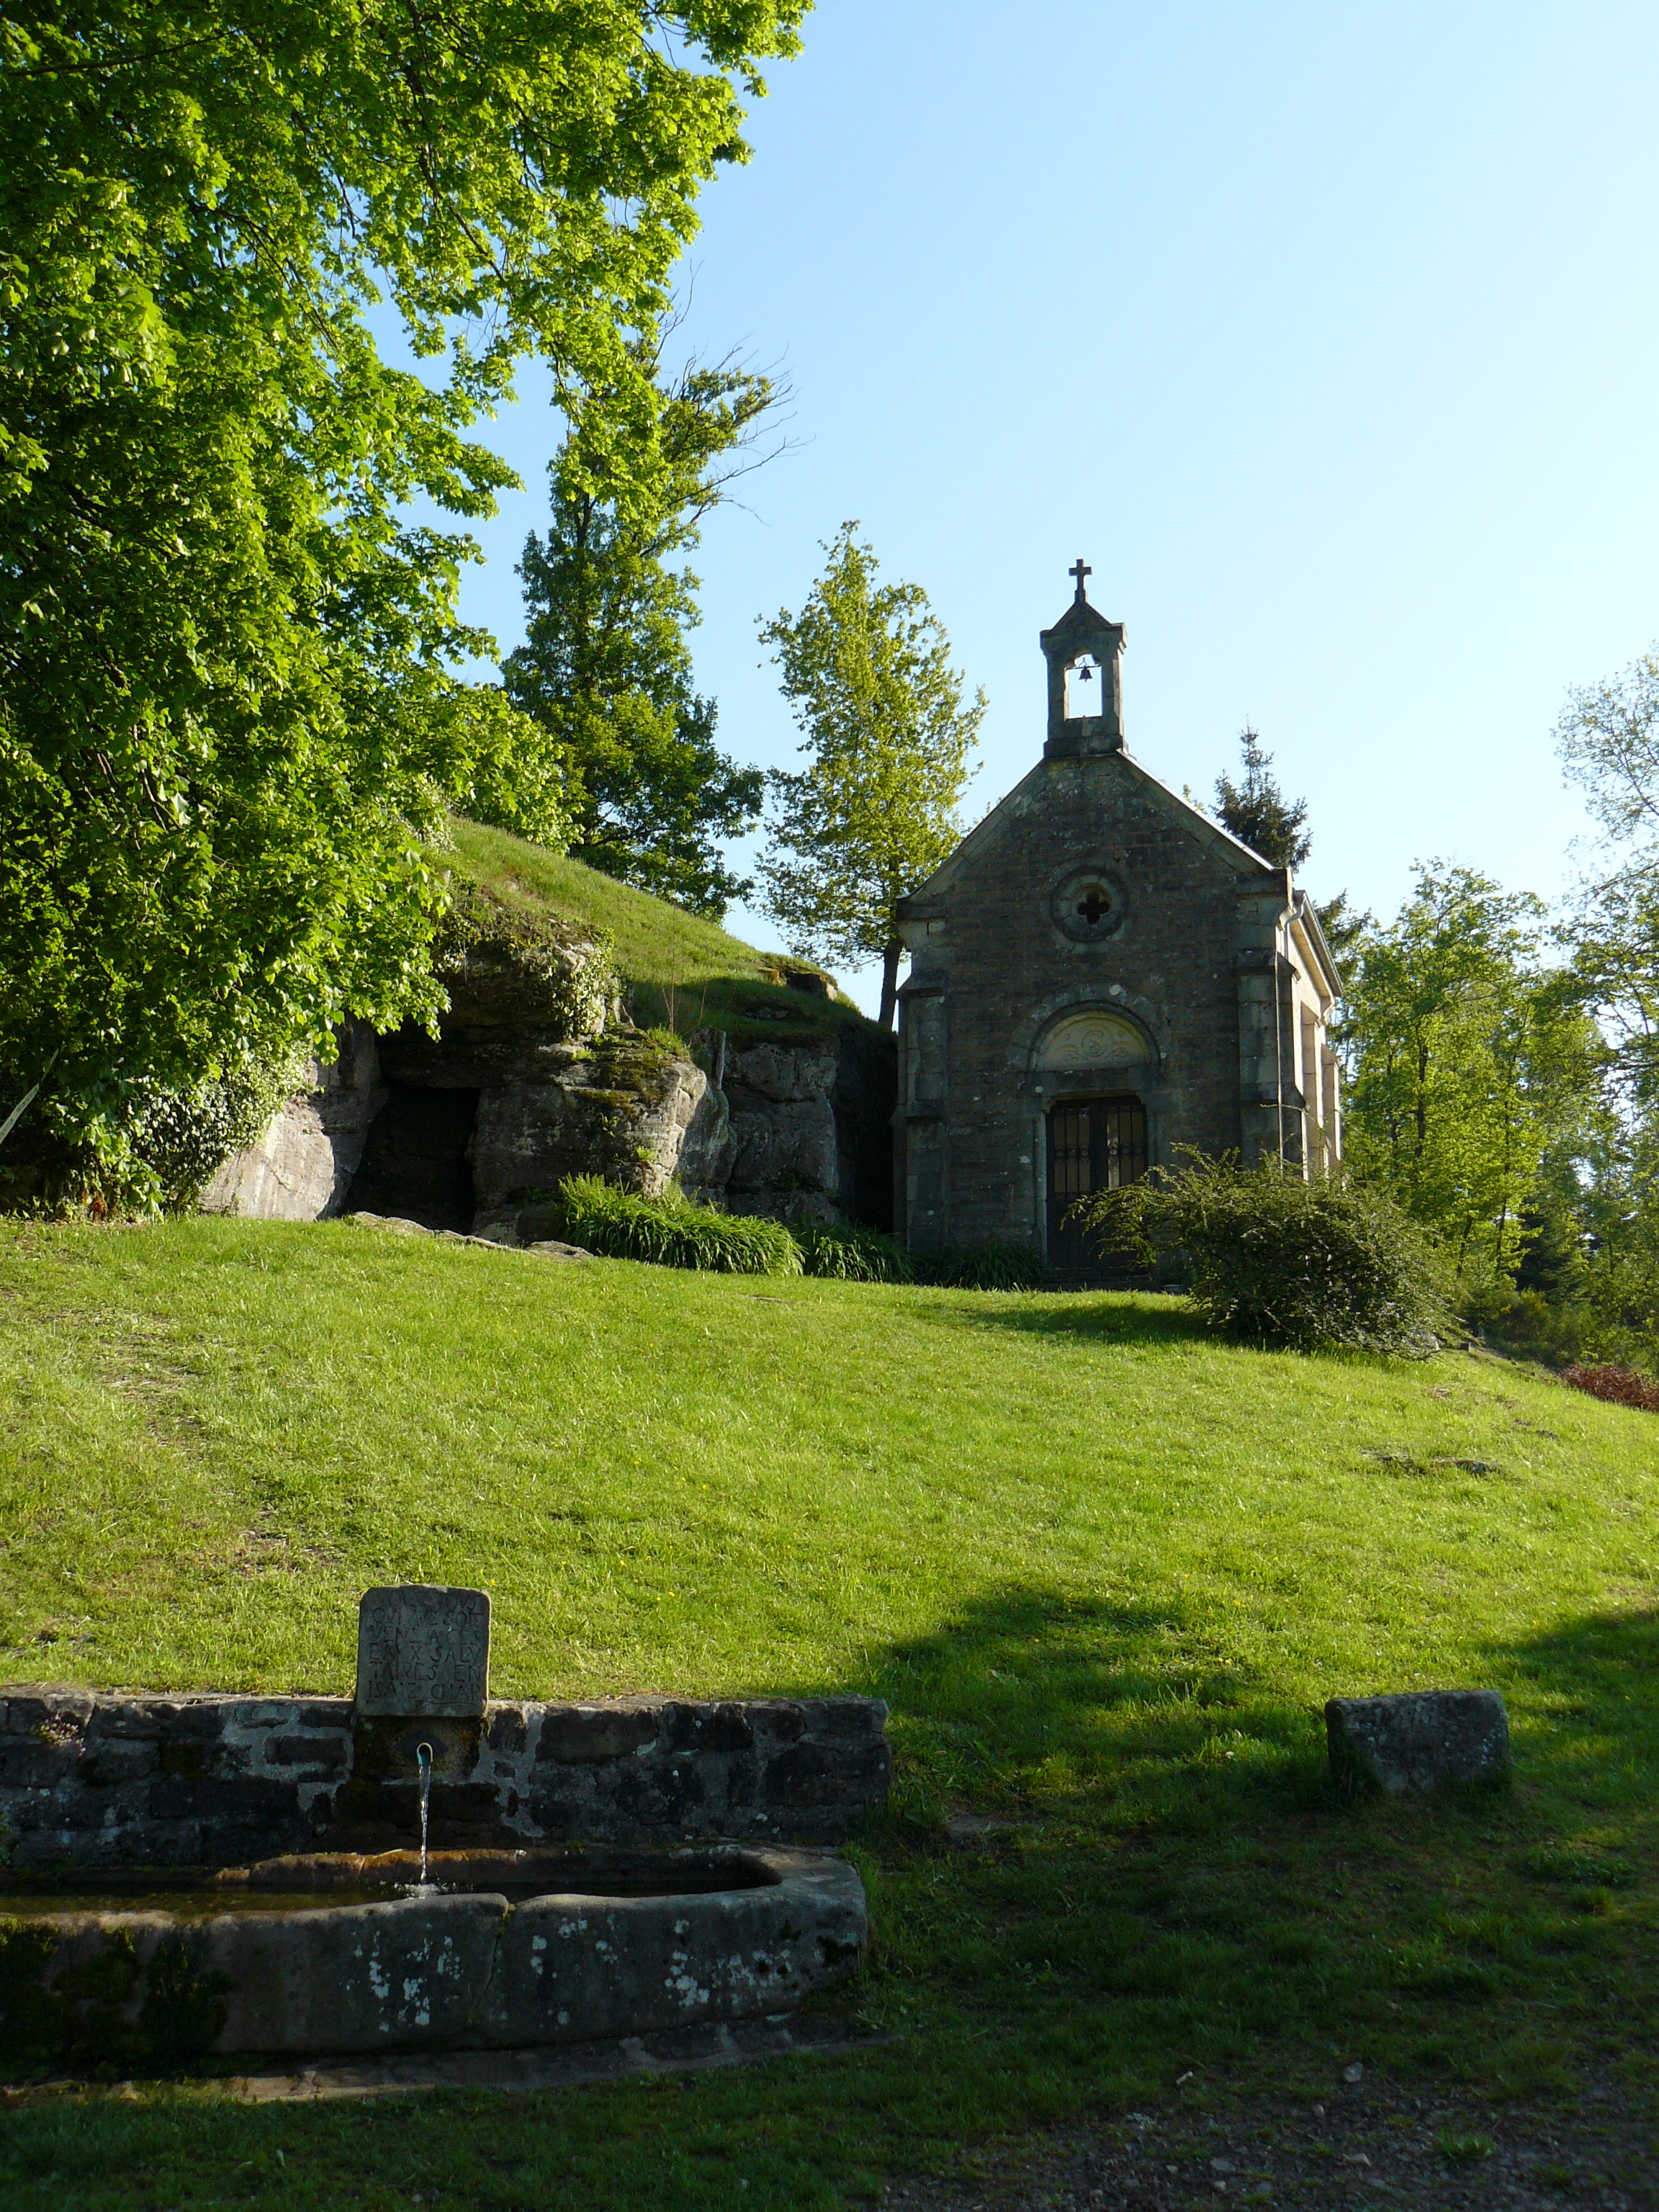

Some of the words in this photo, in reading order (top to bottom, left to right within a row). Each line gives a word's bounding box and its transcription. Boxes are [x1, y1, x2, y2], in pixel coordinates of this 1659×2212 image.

[430, 1642, 482, 1663] SALV
[370, 1660, 439, 1681] TAIRES
[454, 1664, 482, 1683] EN
[431, 1683, 481, 1701] CHAP
